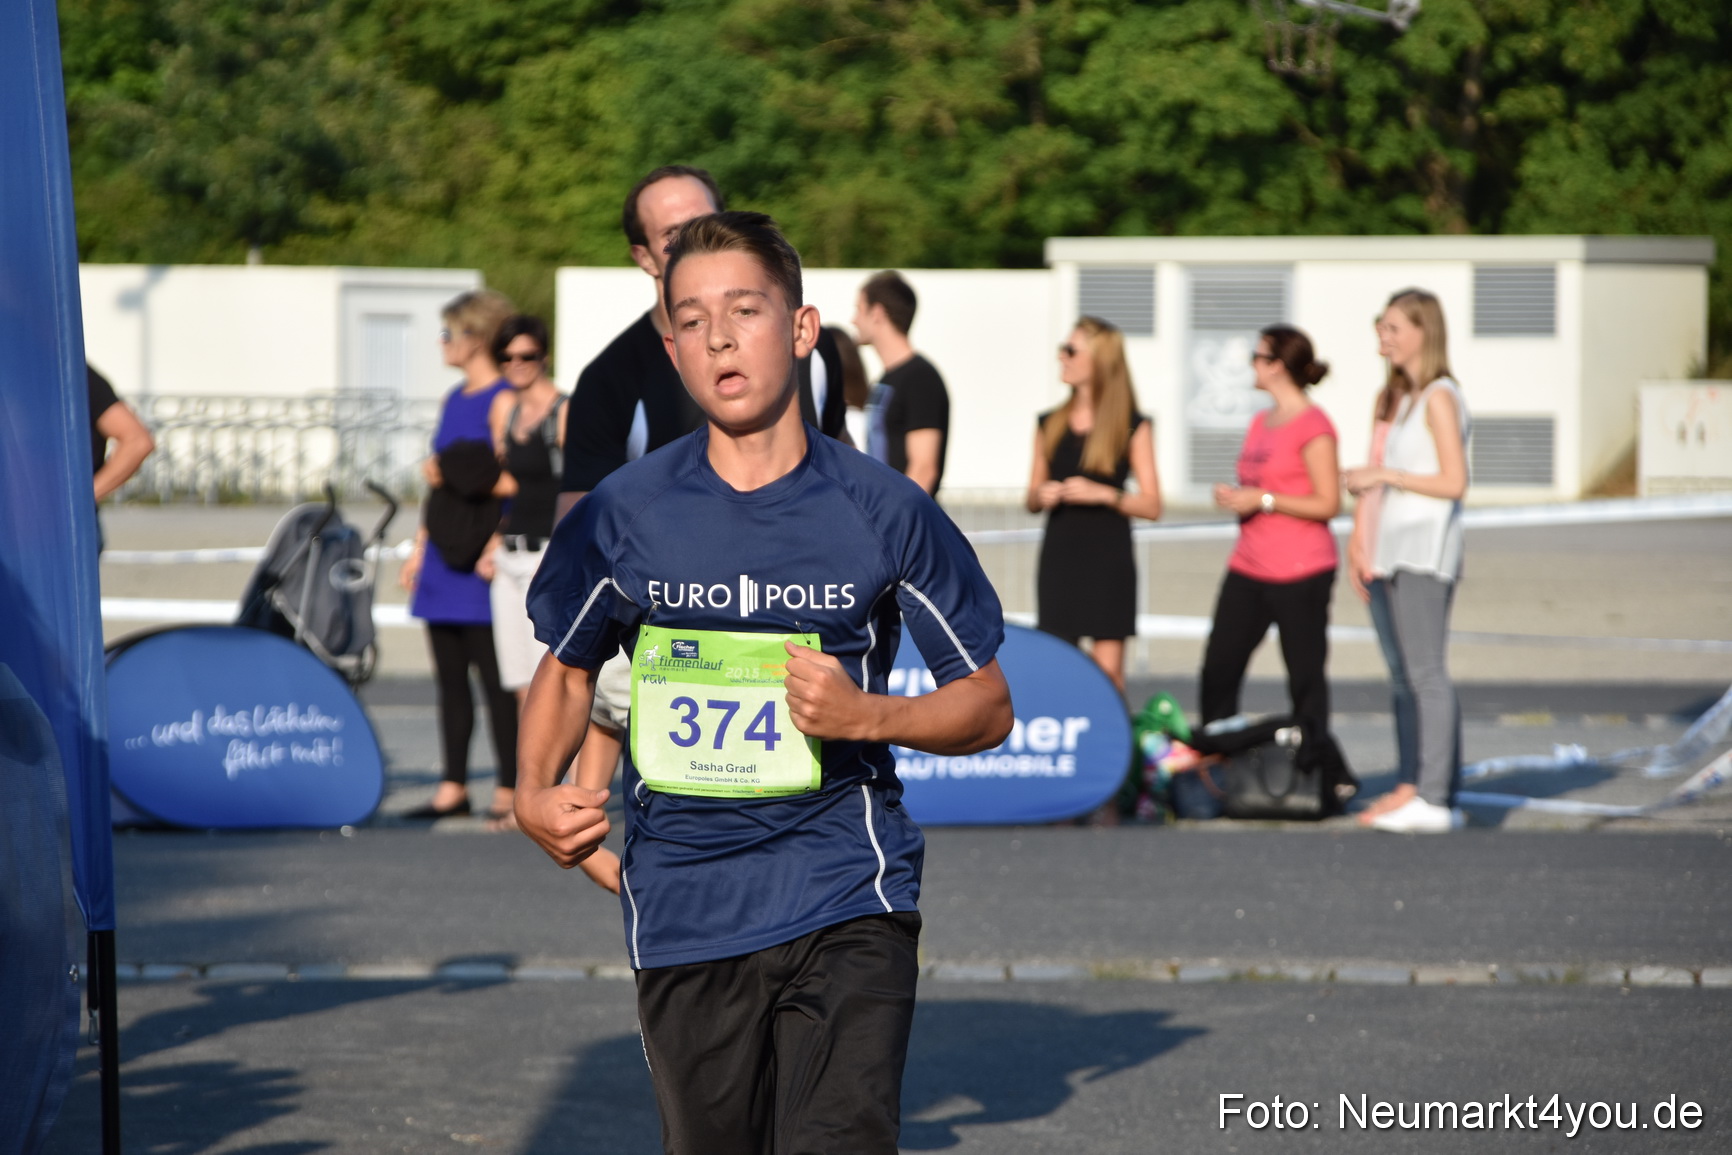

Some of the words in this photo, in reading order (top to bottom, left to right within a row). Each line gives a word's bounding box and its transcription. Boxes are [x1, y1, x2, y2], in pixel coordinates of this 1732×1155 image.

[649, 580, 732, 609] EURO
[766, 583, 856, 610] POLES
[660, 656, 724, 671] firmenlauf
[725, 667, 760, 679] 2015
[668, 696, 782, 751] 374
[690, 760, 724, 773] Sasha
[725, 763, 757, 774] Gradl
[895, 754, 1077, 780] AUTOMOBILE
[685, 774, 714, 782] Europoles
